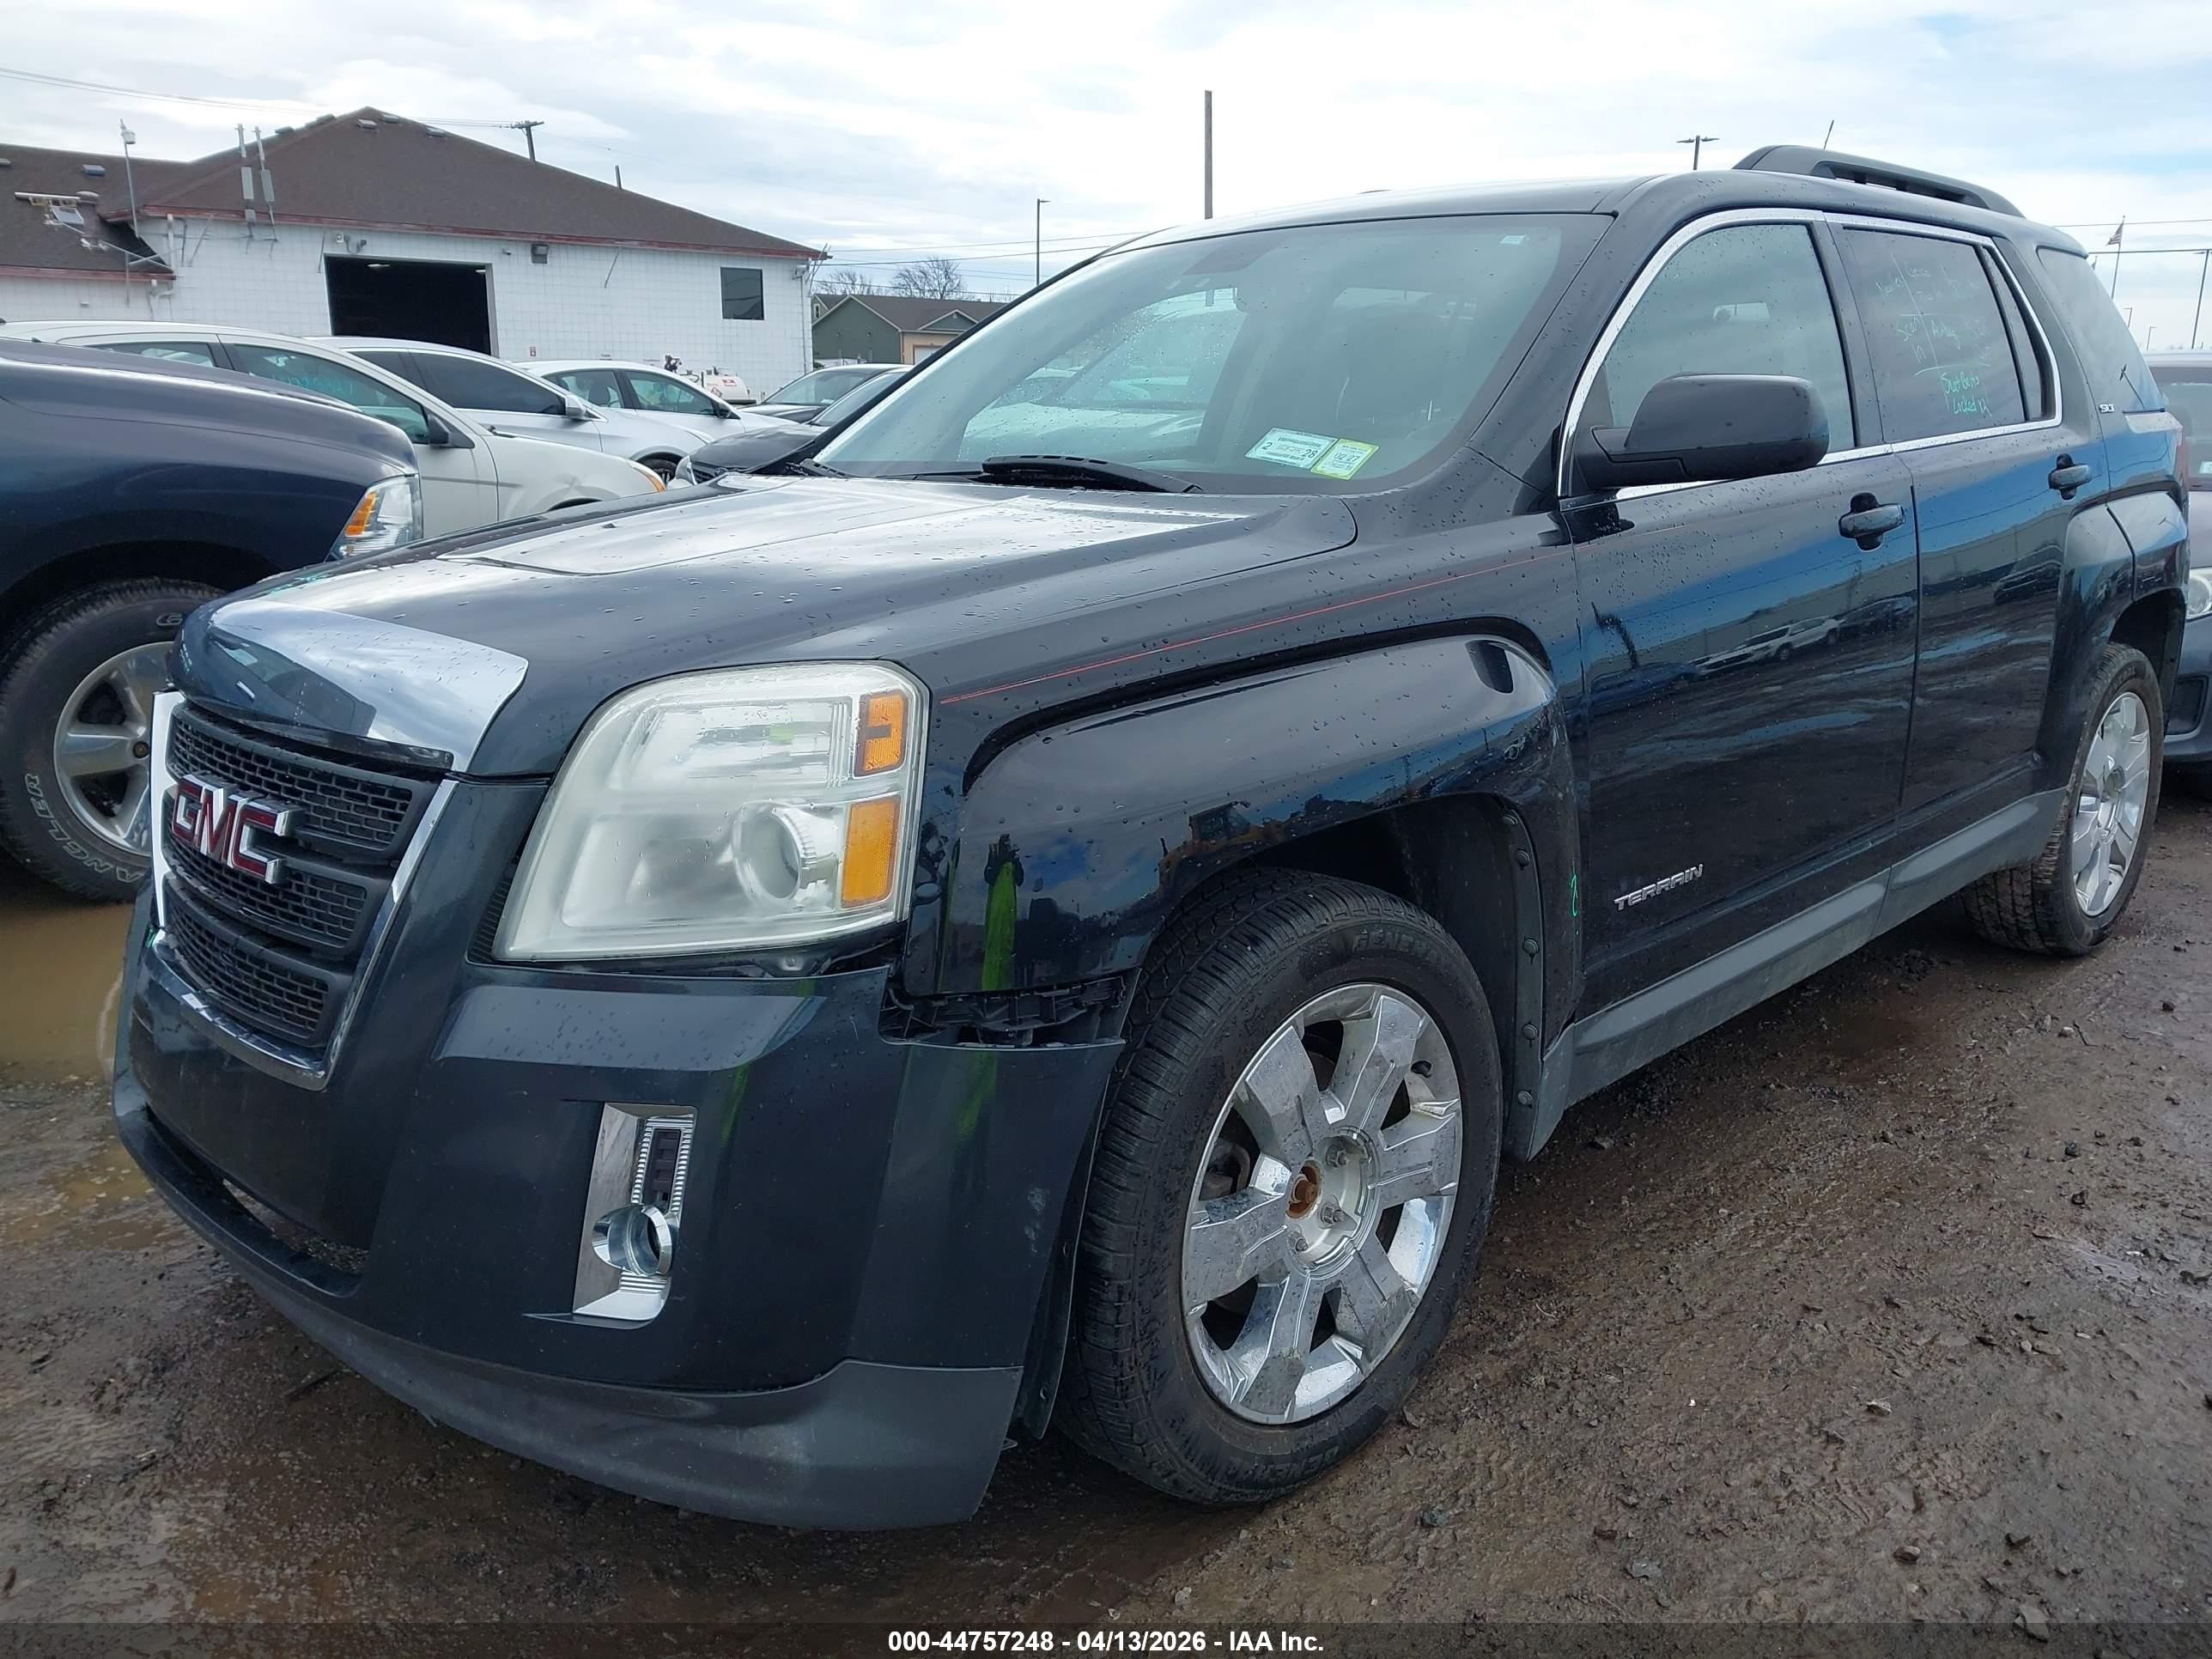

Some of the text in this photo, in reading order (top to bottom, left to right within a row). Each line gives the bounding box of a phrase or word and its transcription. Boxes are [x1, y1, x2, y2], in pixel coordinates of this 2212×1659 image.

[1302, 448, 1319, 459] 28
[24, 773, 145, 884] ANGLER
[172, 774, 291, 884] GMC
[1613, 863, 1704, 911] TERRAIN
